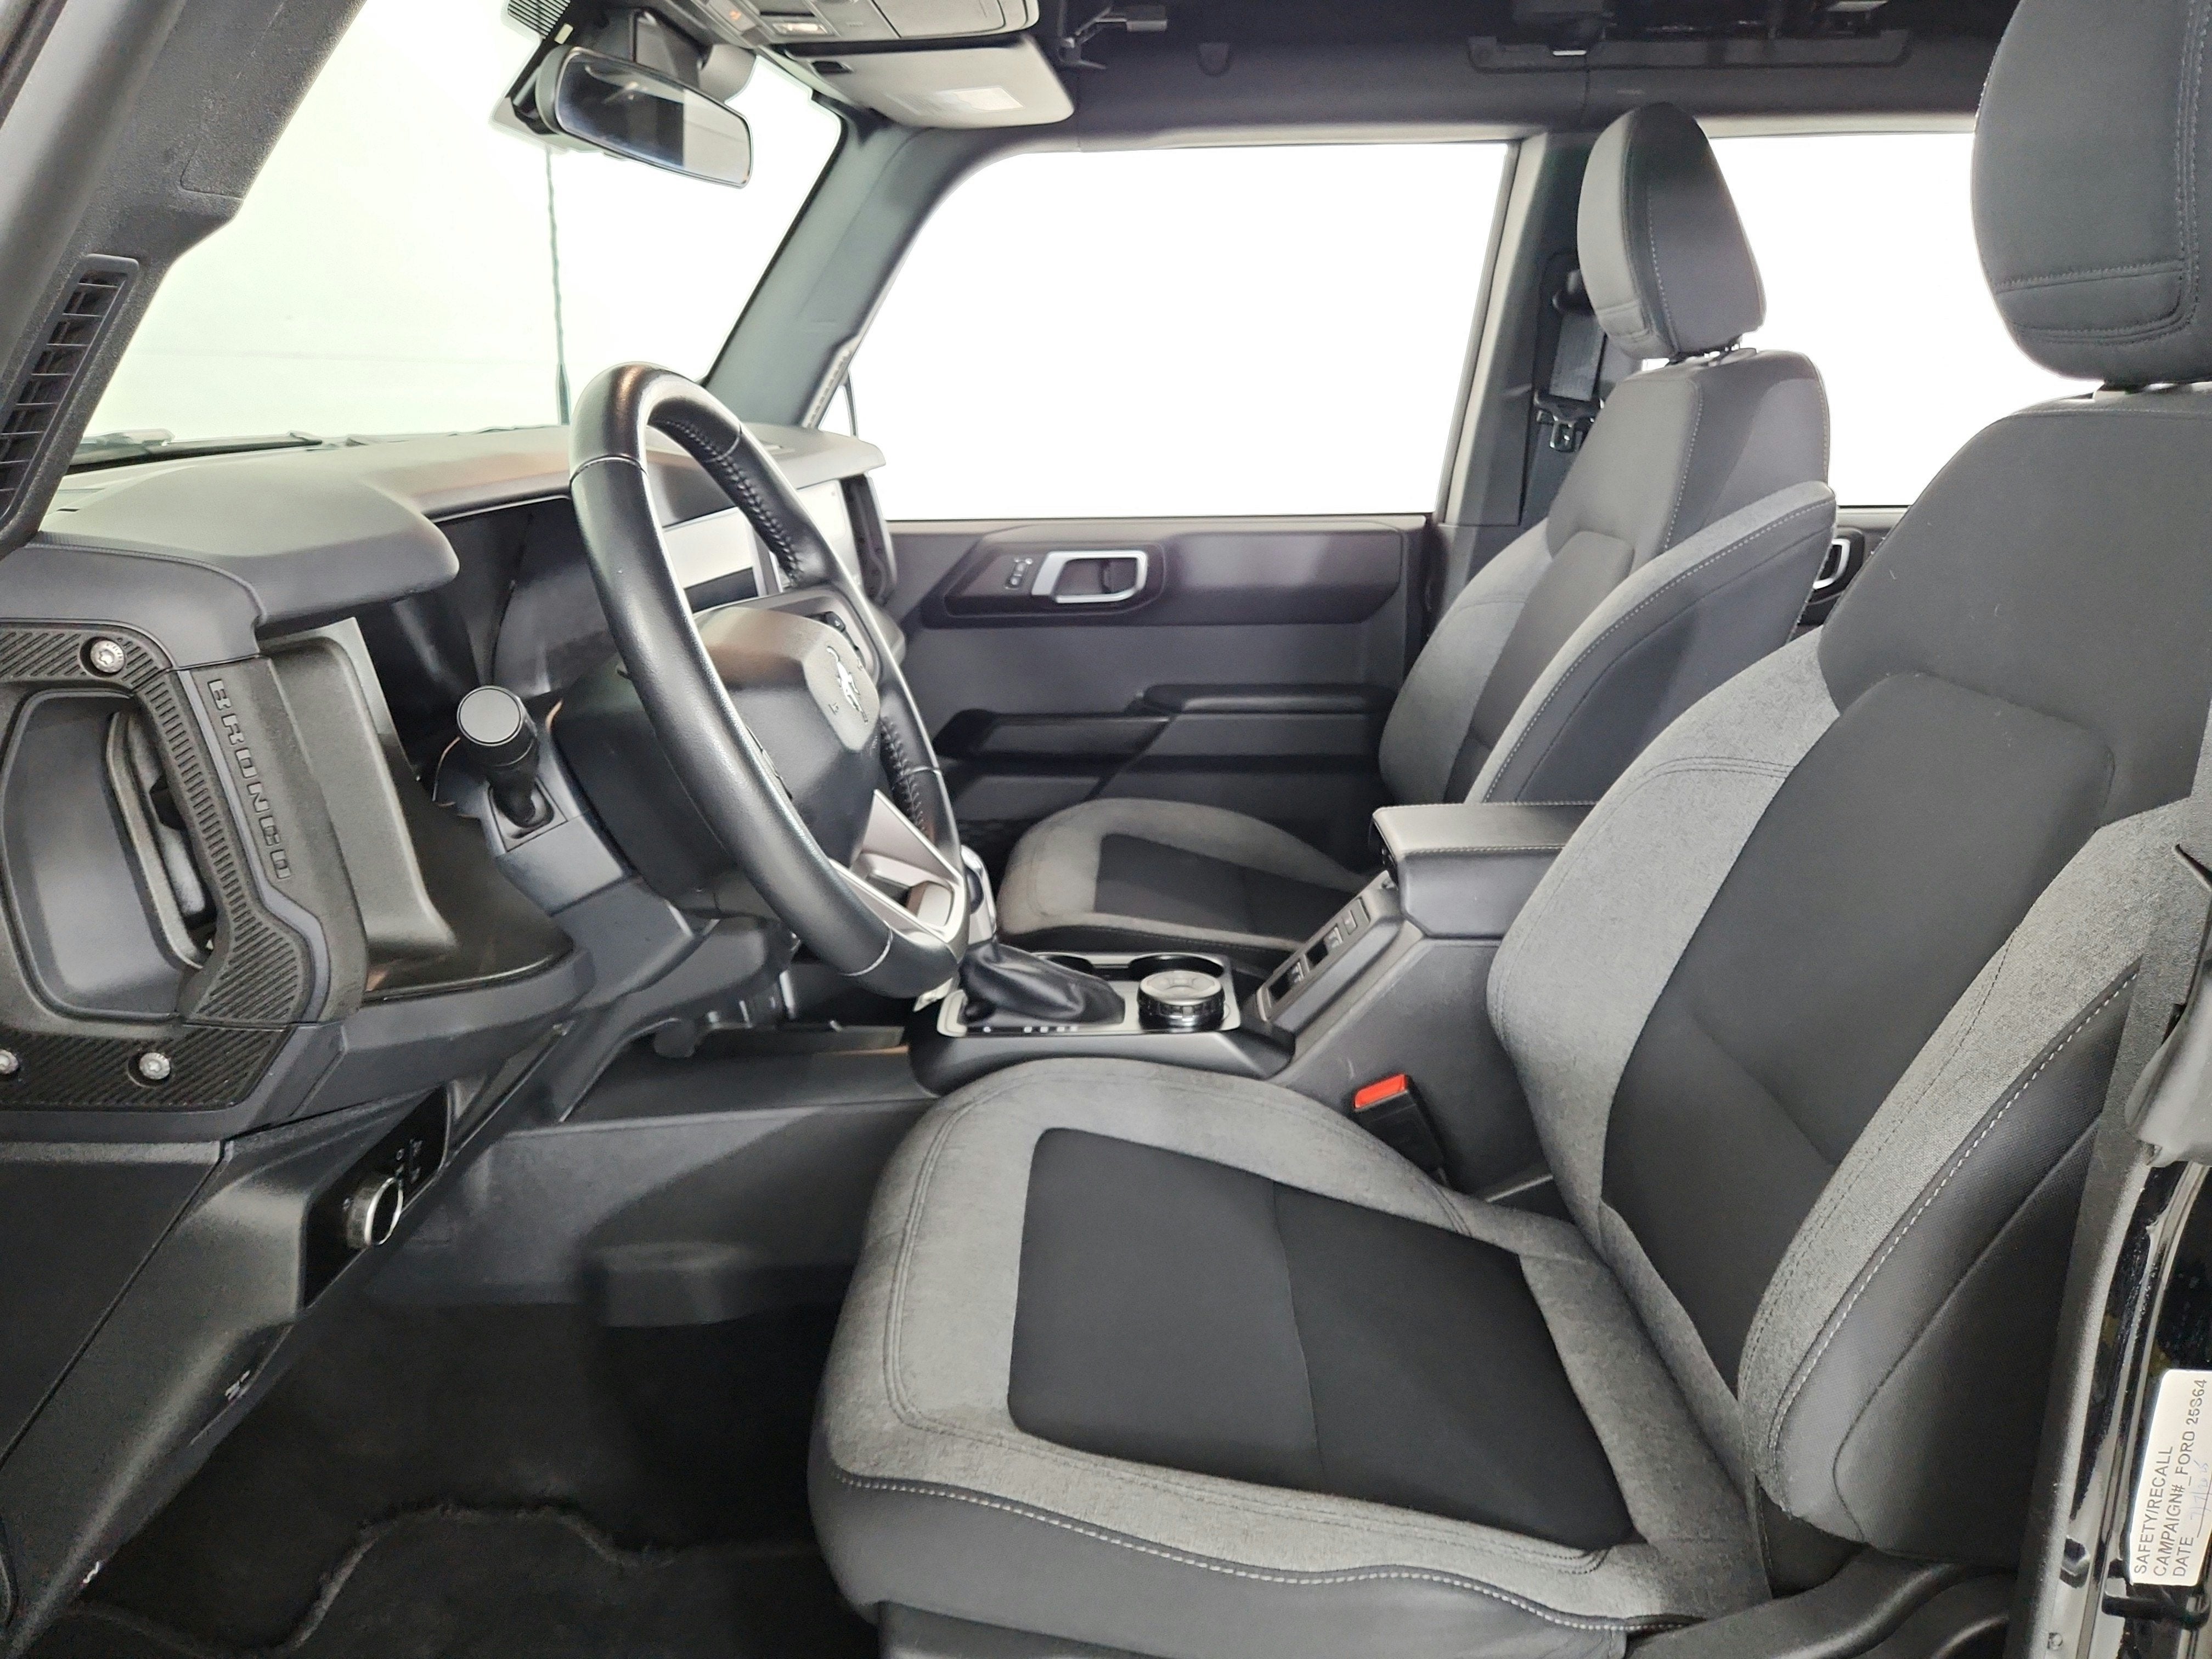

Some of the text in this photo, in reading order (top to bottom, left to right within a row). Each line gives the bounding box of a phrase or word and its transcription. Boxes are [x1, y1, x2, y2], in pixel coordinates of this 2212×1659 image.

[207, 679, 292, 880] BRONCO
[2186, 1379, 2207, 1425] 25S64
[2135, 1446, 2173, 1575] SAFETY/RECALL
[2174, 1537, 2194, 1576] DATE
